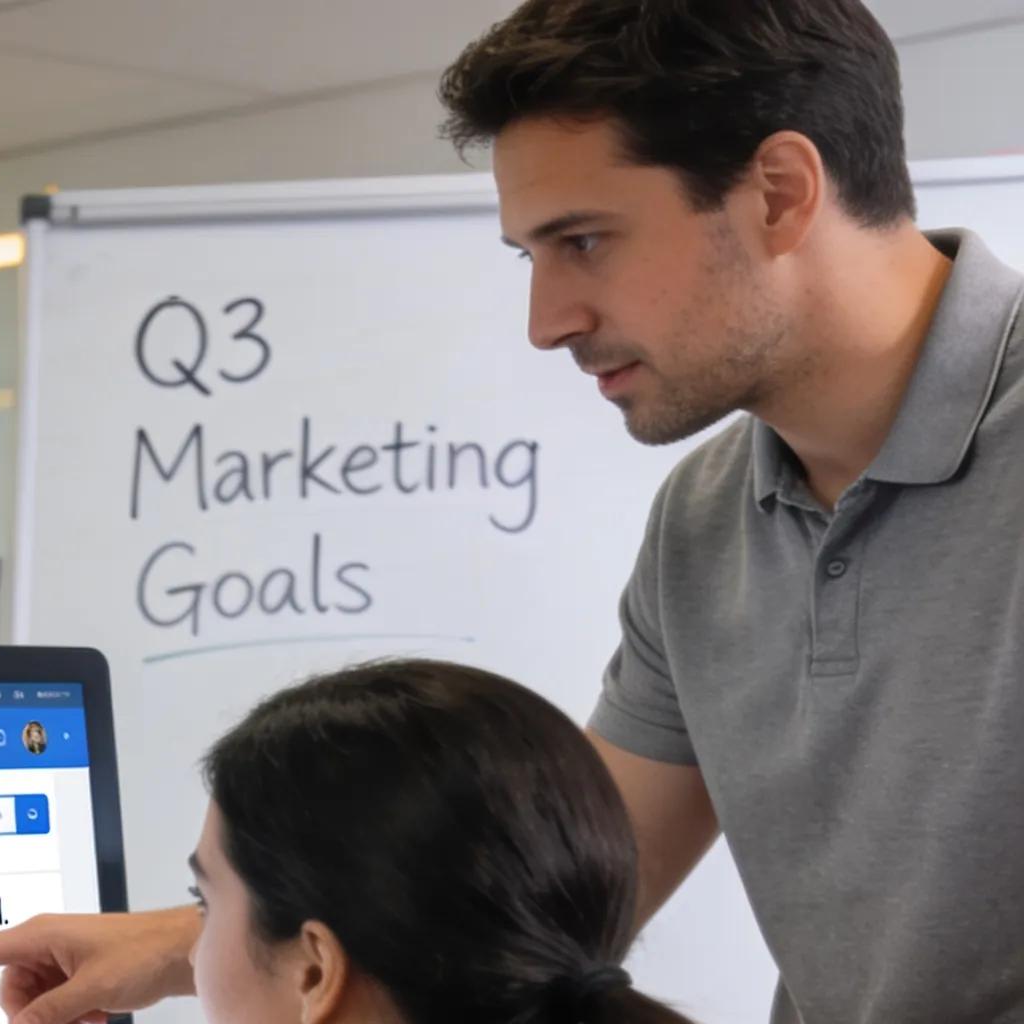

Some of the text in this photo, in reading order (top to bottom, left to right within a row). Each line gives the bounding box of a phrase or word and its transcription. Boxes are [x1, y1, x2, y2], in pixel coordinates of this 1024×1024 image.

[133, 294, 272, 397] Q3
[130, 416, 539, 533] Marketing
[136, 532, 374, 636] Goals
